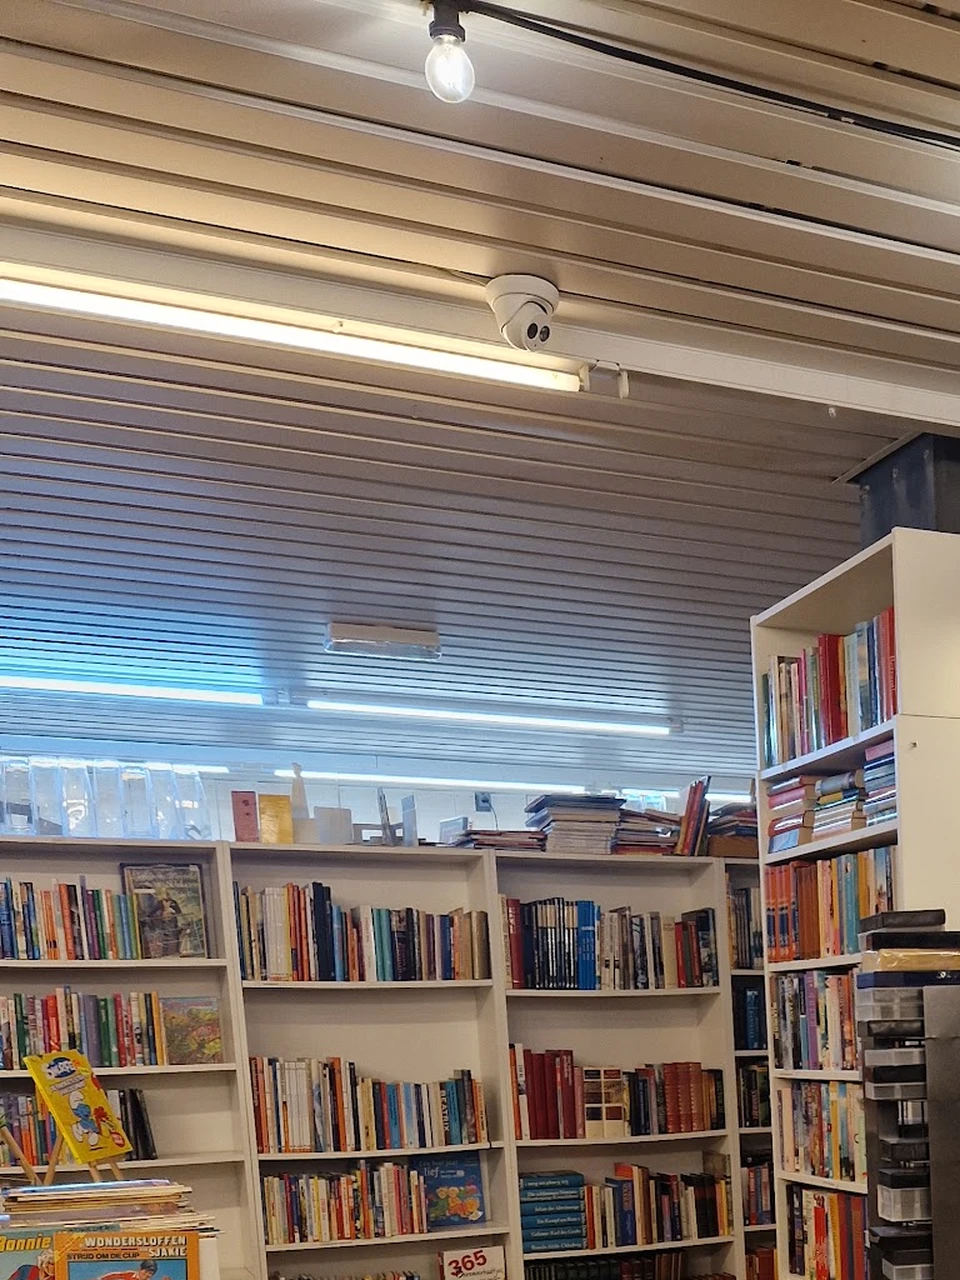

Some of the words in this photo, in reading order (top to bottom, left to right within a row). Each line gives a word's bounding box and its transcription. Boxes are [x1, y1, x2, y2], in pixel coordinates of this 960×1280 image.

[439, 1089, 451, 1132] BEATRIX
[424, 1167, 439, 1178] lief
[84, 1235, 187, 1248] WONDERSLOFFEN
[149, 1247, 187, 1257] SJAKIE
[448, 1250, 488, 1277] 365
